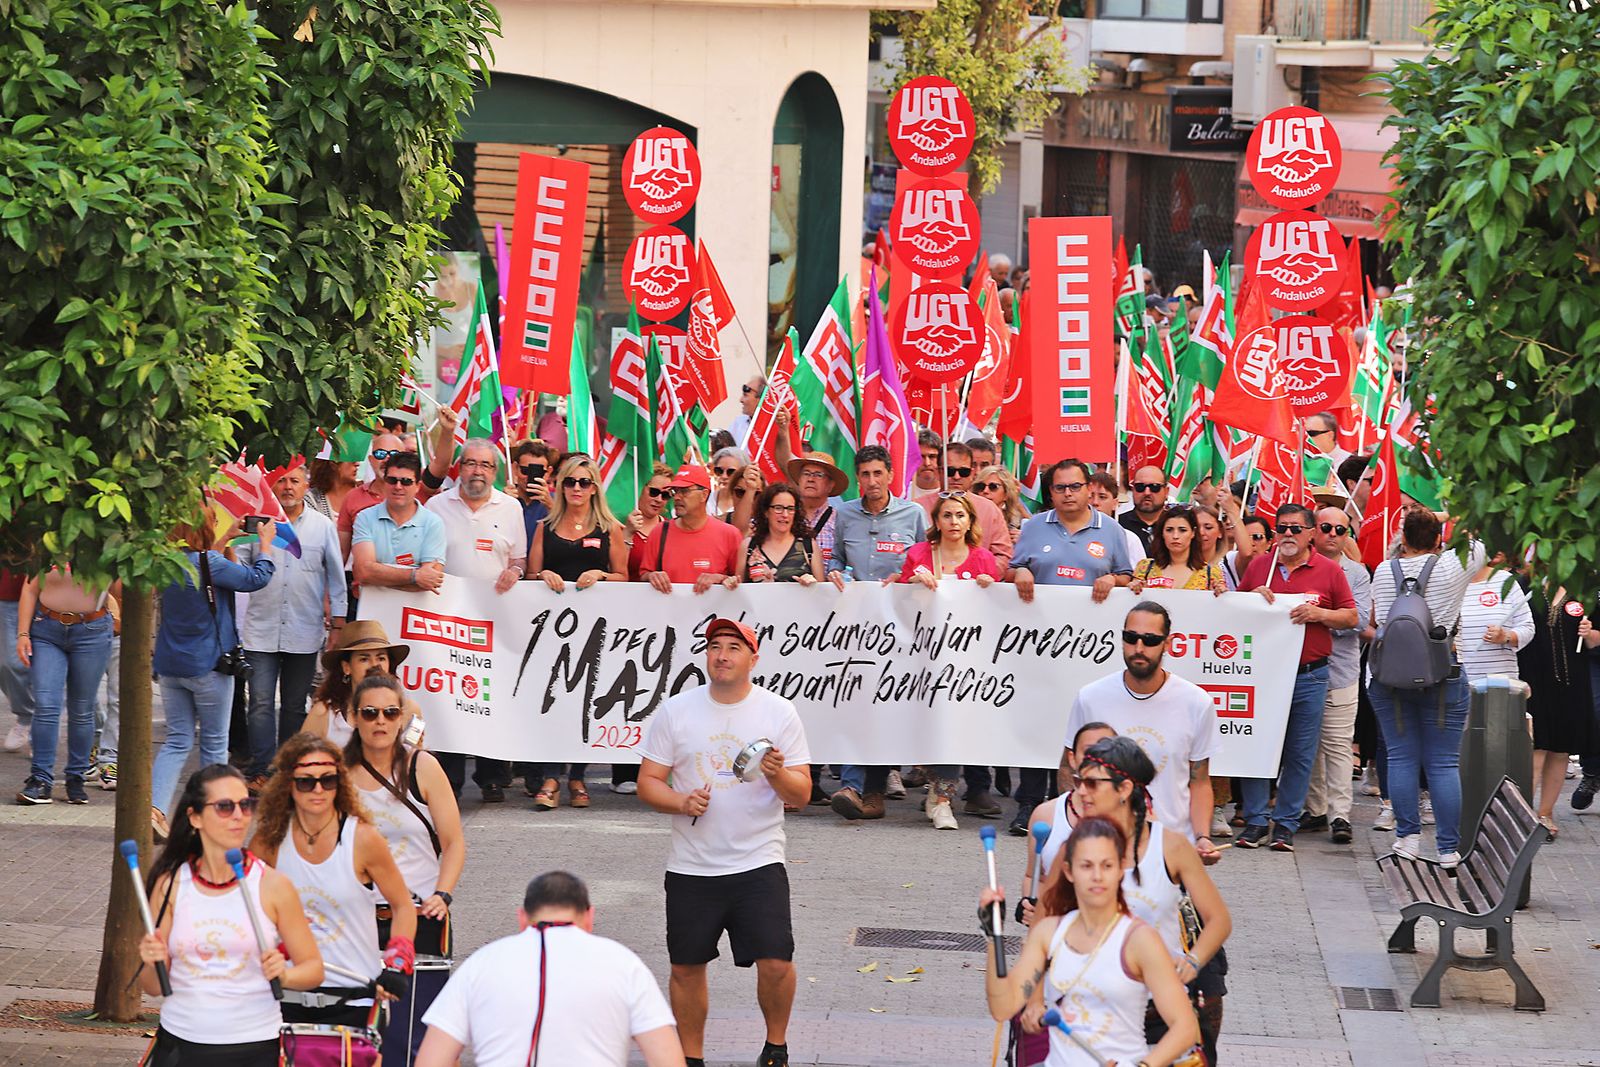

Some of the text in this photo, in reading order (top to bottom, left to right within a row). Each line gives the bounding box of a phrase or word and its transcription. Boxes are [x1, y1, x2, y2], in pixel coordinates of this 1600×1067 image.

[902, 87, 959, 120] UGT
[1262, 116, 1325, 151] UGT
[634, 138, 688, 171] UGT
[910, 152, 956, 167] Andalucía
[1271, 183, 1321, 198] Andalucía
[640, 200, 683, 214] Andalucía
[904, 189, 964, 224] UGT
[1261, 220, 1329, 255] UGT
[634, 234, 687, 269] UGT
[912, 255, 960, 269] Andalucía
[1271, 286, 1325, 301] Andalucía
[640, 296, 681, 313] Andalucía
[905, 294, 970, 328] UGT
[520, 354, 548, 367] HUELVA
[916, 357, 965, 372] Andalucía
[1289, 391, 1328, 406] dalucía
[1060, 424, 1091, 433] HUELVA
[1057, 567, 1076, 577] UGT
[609, 628, 647, 653] DE
[909, 611, 982, 662] bajar
[992, 623, 1115, 664] precios
[1168, 632, 1208, 659] GT
[449, 649, 492, 669] Huelva
[1202, 661, 1252, 675] Huelva
[403, 665, 458, 694] UGT
[873, 659, 1015, 708] beneficios
[455, 699, 491, 716] Huelva
[591, 725, 642, 749] 2023
[1220, 720, 1253, 736] elva
